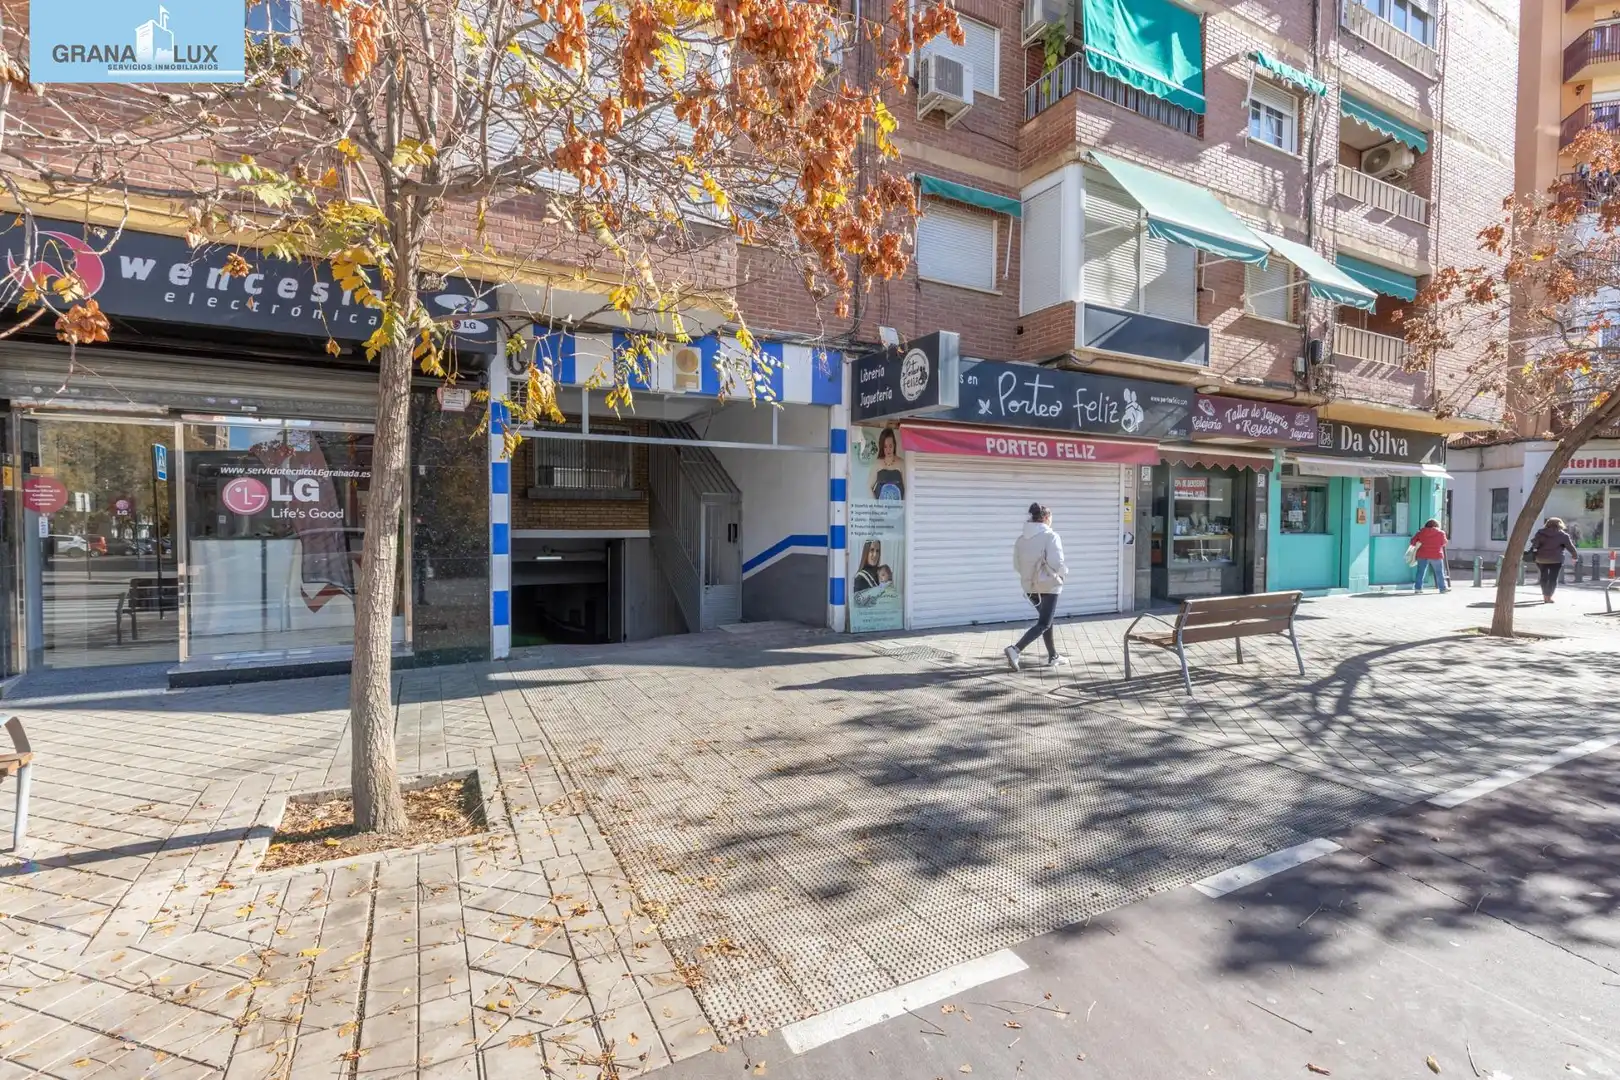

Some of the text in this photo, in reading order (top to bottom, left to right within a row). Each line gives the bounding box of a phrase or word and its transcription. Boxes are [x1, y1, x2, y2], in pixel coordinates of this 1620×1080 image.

[164, 290, 378, 326] electrónica
[463, 321, 477, 330] LG
[998, 371, 1062, 417] Porteo
[1225, 404, 1249, 423] Taller
[1250, 404, 1261, 418] de
[1242, 419, 1274, 437] Reyes
[986, 437, 1048, 457] PORTEO
[1340, 424, 1363, 452] Da
[1368, 428, 1409, 456] Silva
[271, 477, 320, 502] LG
[271, 508, 344, 519] Life's Good
